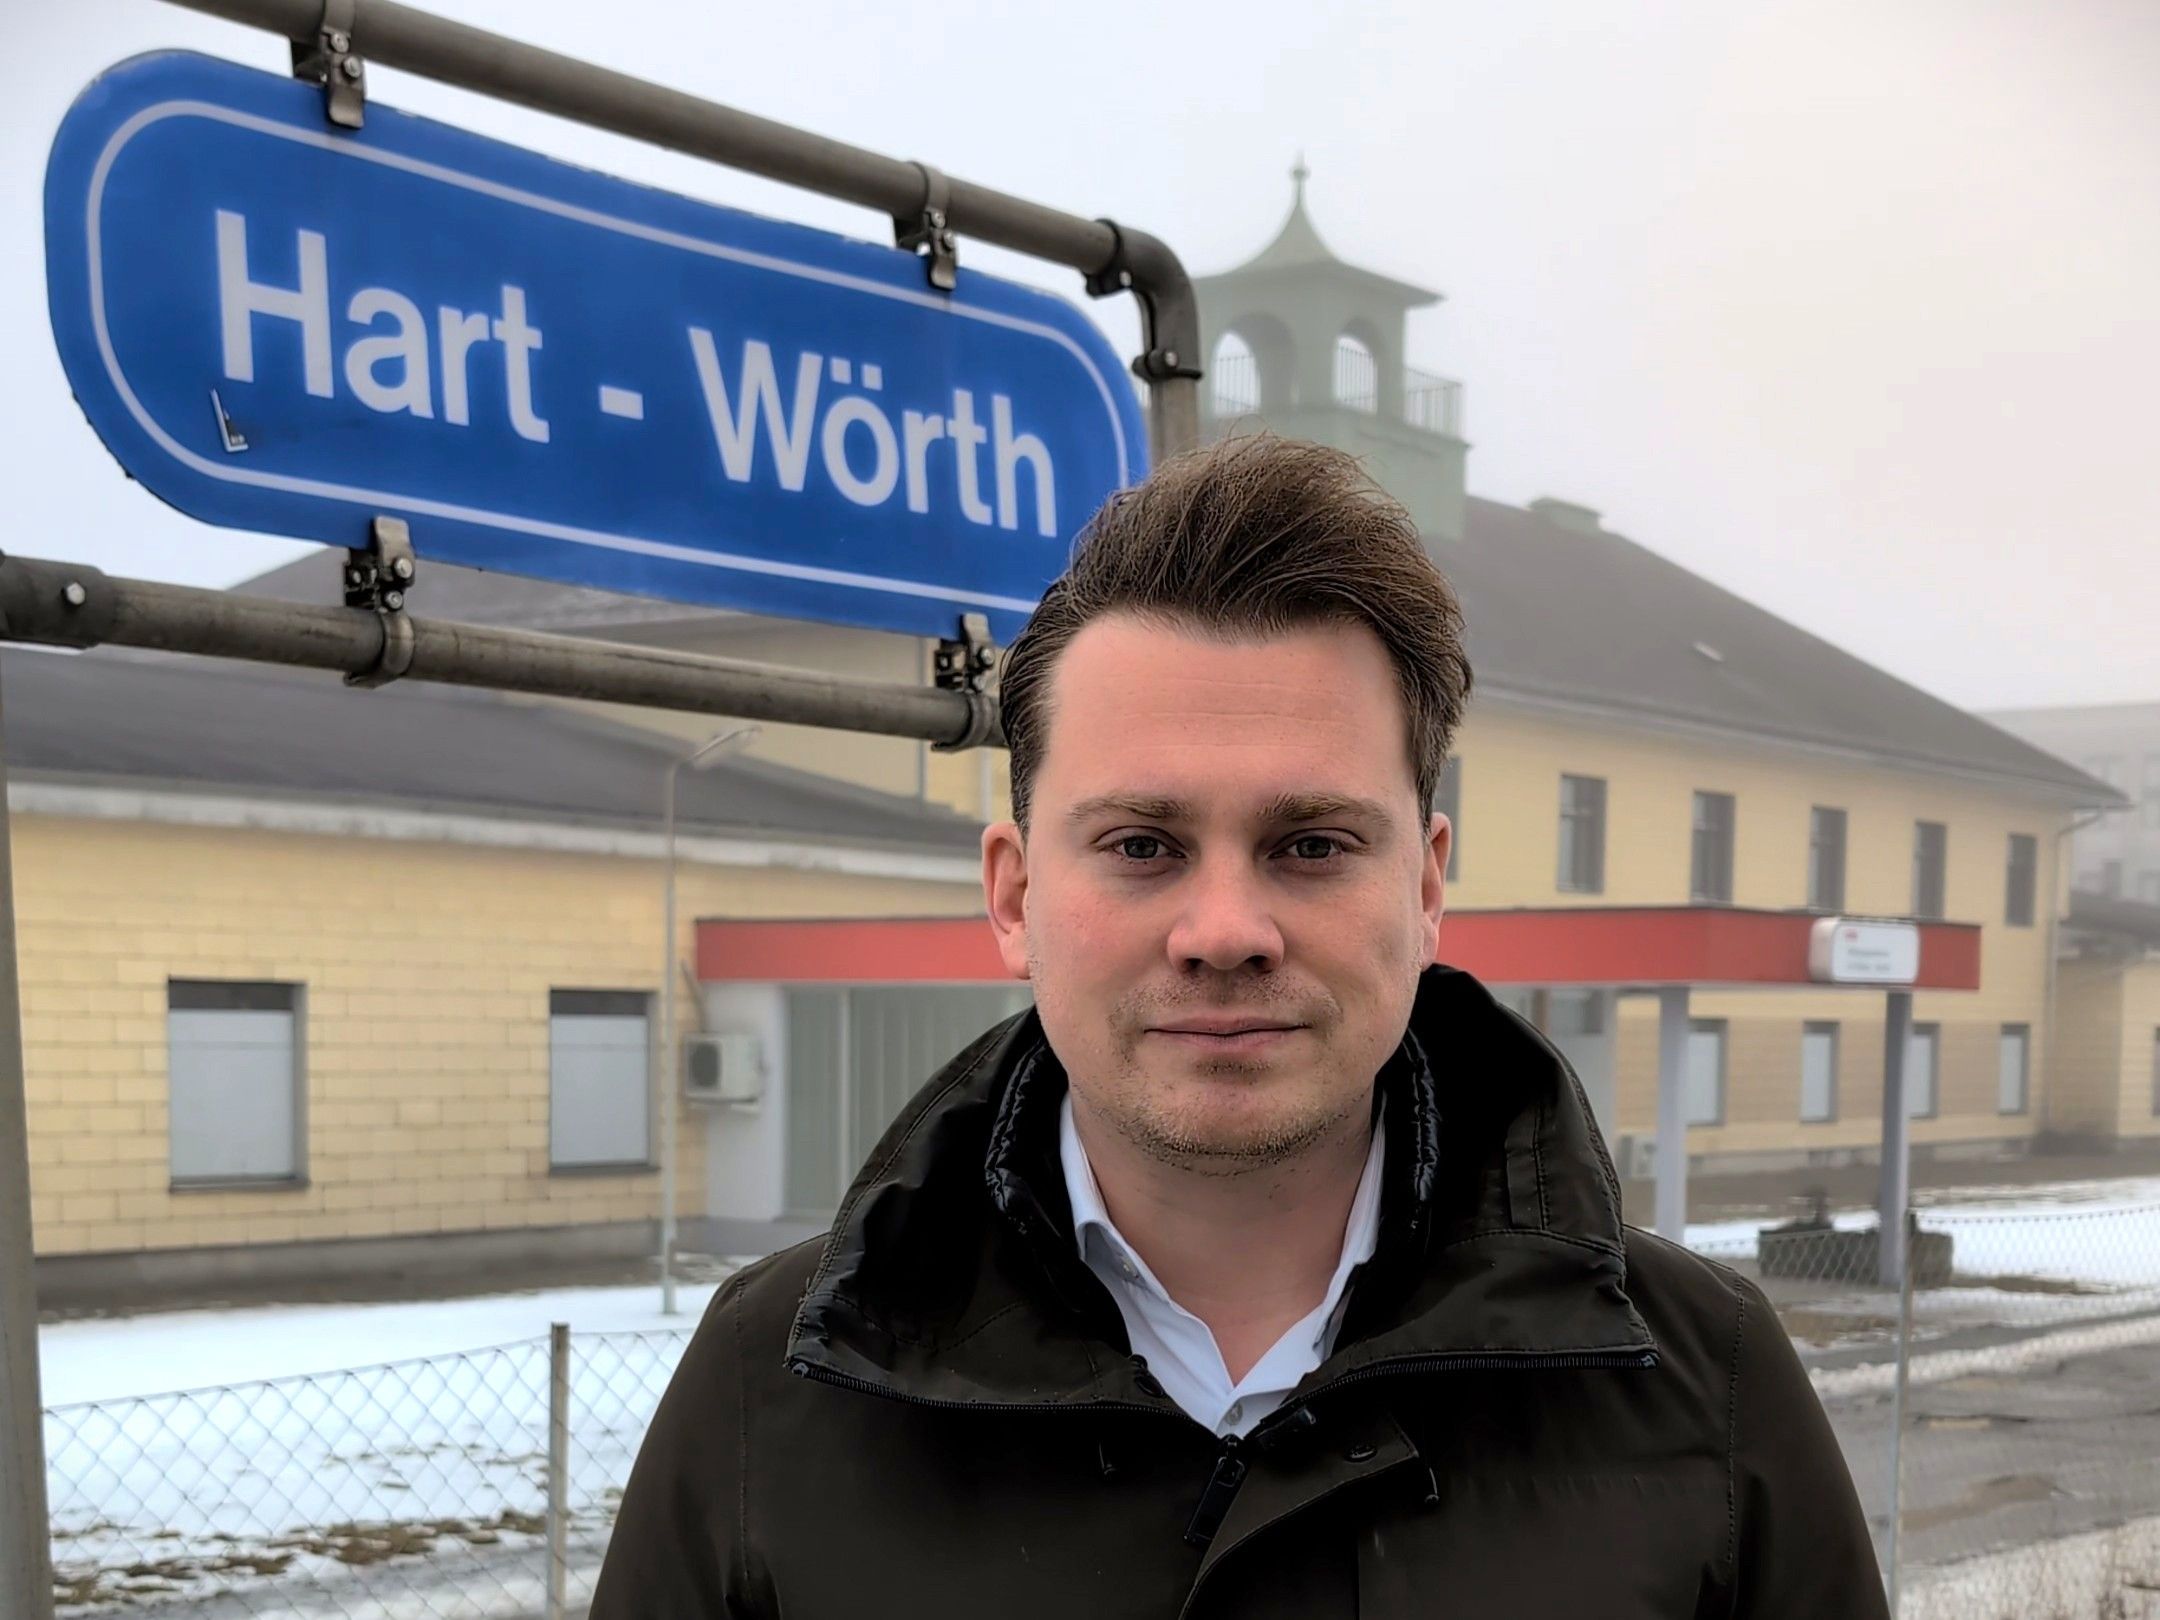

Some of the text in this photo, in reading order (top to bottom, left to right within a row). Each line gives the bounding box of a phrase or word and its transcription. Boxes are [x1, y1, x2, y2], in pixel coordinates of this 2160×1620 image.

[216, 208, 1058, 538] Hart - Wörth
